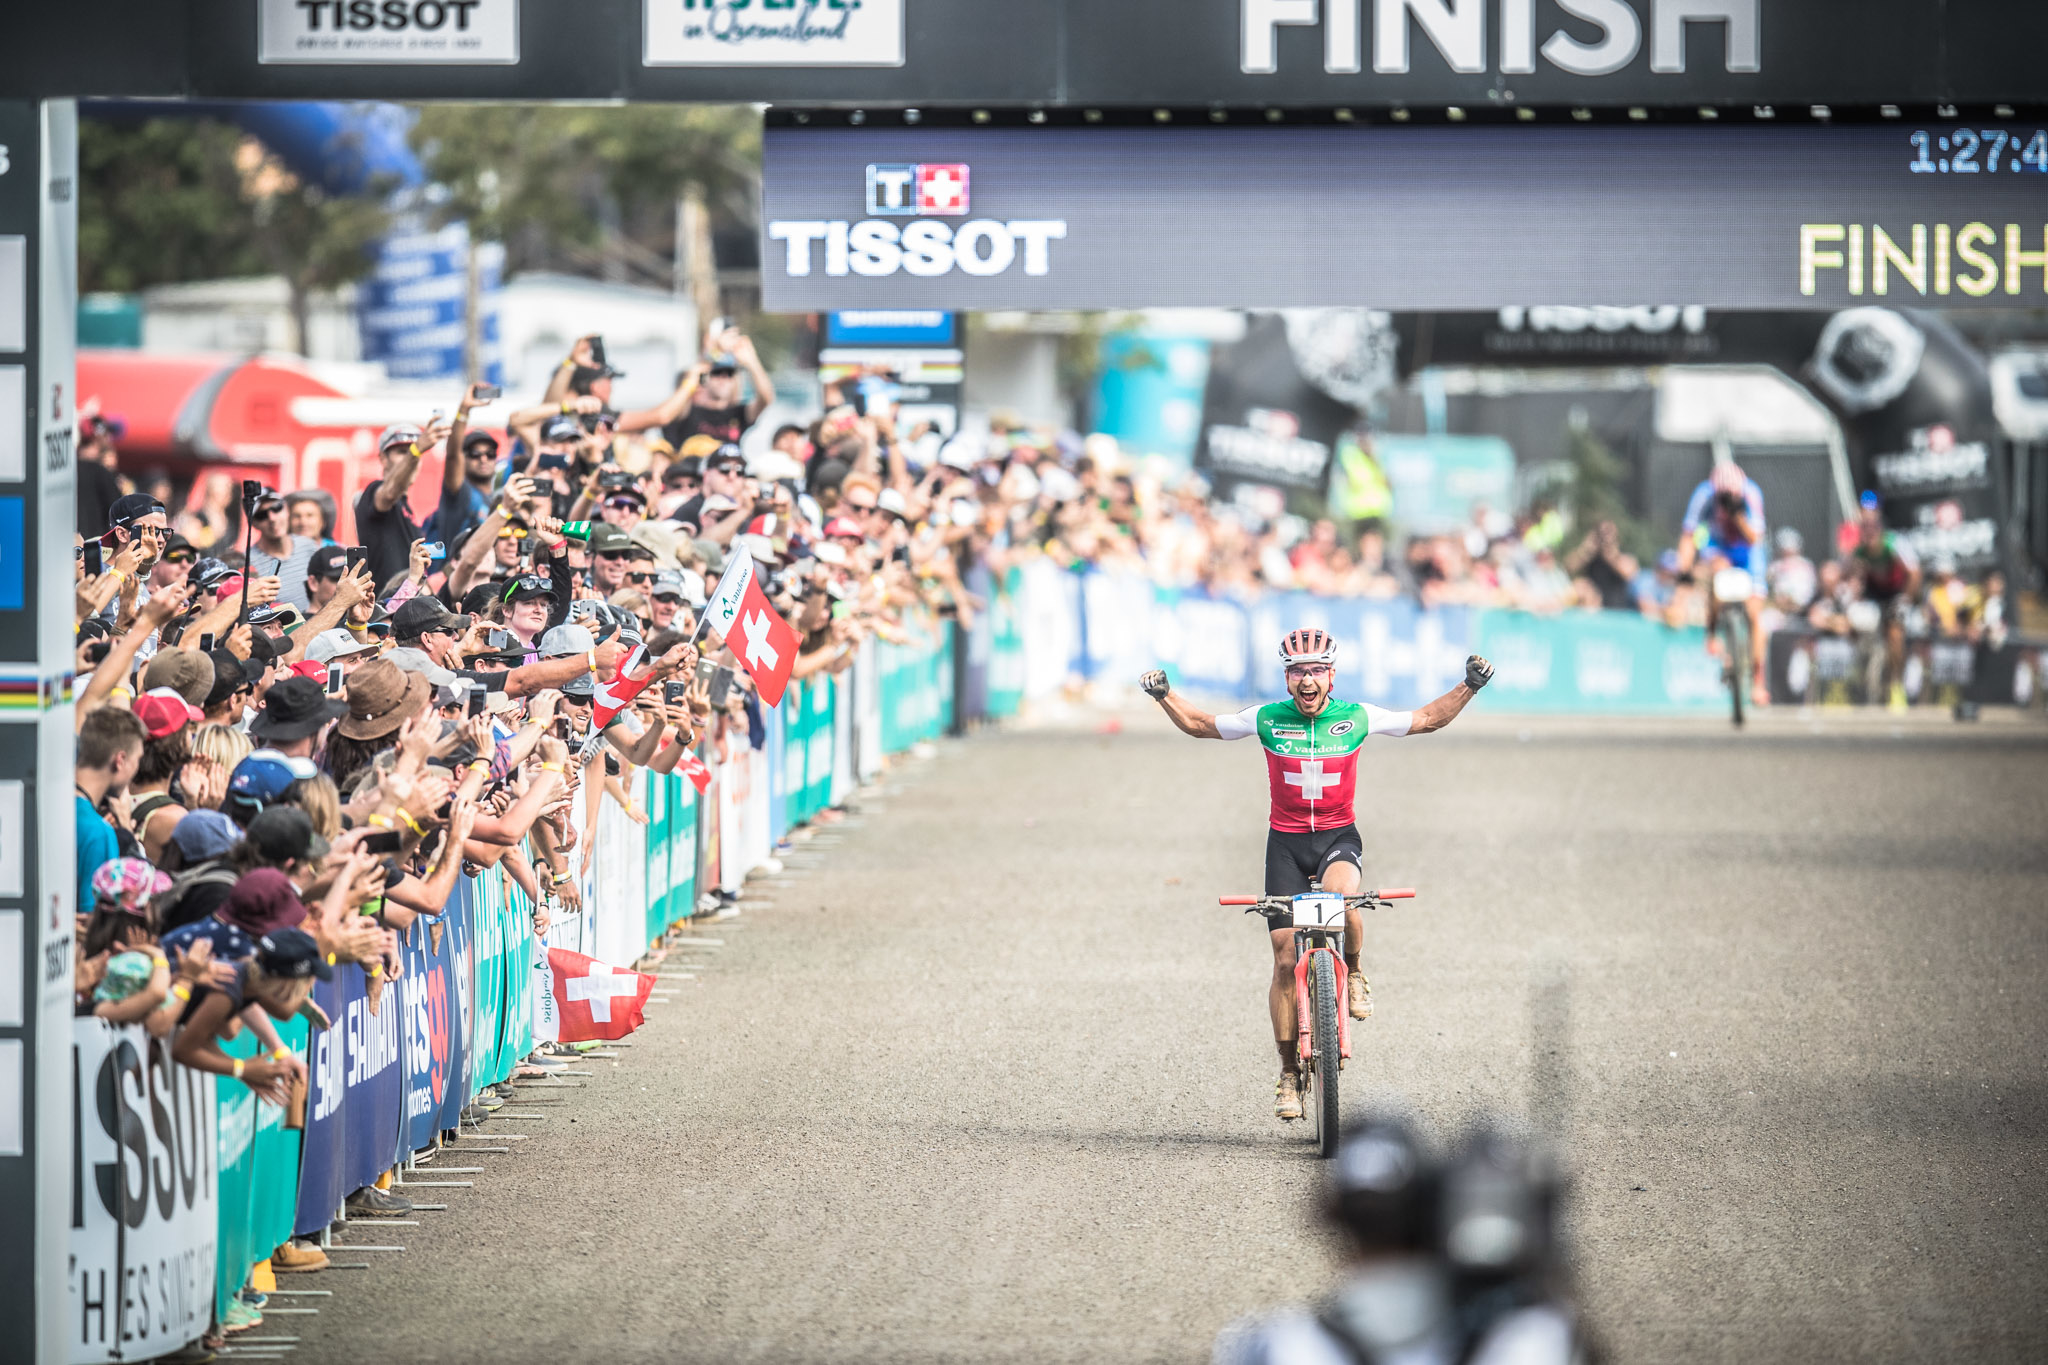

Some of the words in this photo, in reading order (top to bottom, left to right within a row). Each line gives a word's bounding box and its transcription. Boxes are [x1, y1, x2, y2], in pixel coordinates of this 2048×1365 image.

[297, 0, 480, 31] TISSOT
[1240, 0, 1761, 75] FINISH
[769, 219, 1067, 276] TISSOT
[1800, 222, 2048, 297] FINISH
[1295, 744, 1350, 754] vaudoise
[1314, 902, 1323, 924] 1
